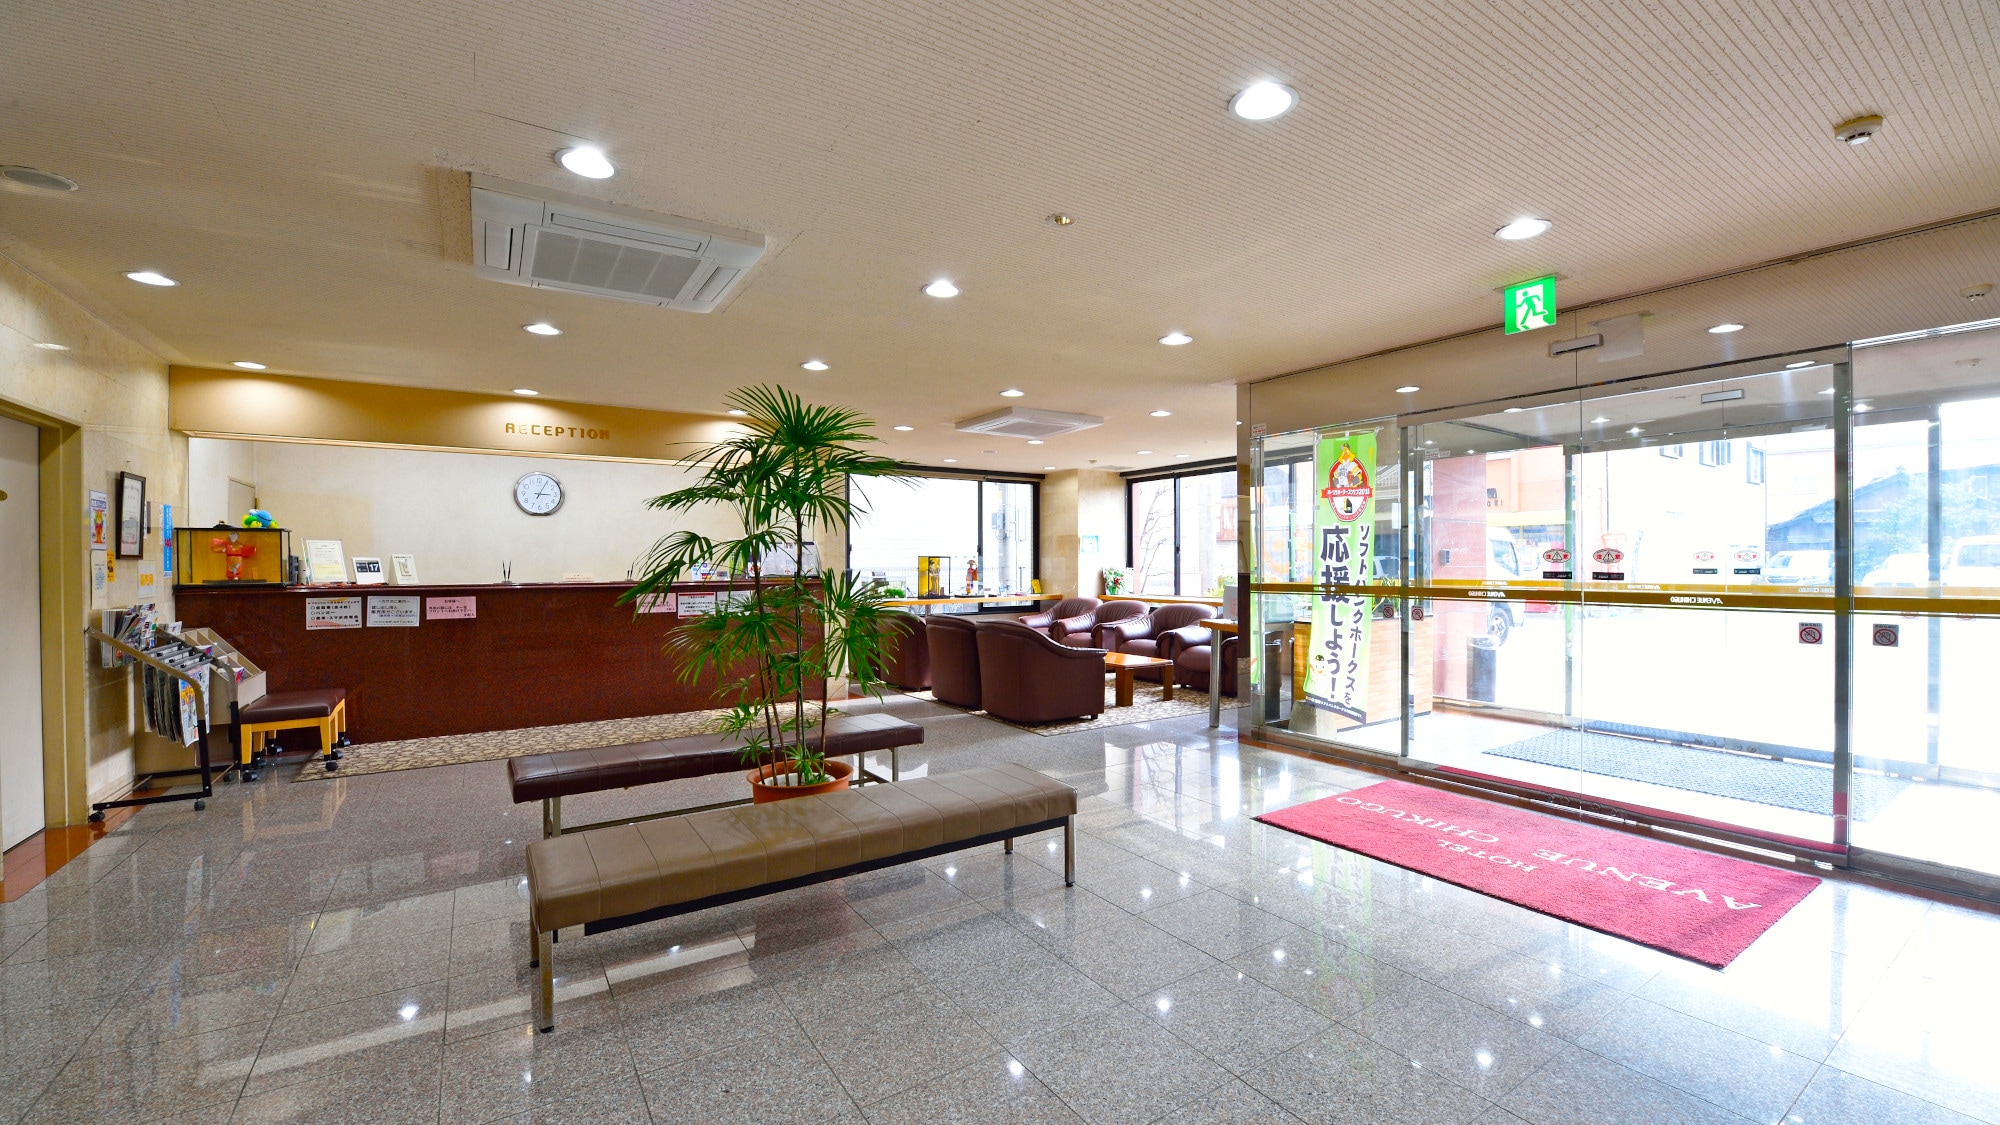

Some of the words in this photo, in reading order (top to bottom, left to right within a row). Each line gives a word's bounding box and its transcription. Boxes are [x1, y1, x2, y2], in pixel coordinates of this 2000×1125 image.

[505, 422, 610, 440] RECEPTION
[1336, 797, 1498, 843] CHIKUGO
[1438, 839, 1538, 873] HOTEL
[1532, 849, 1762, 910] AVENUE
